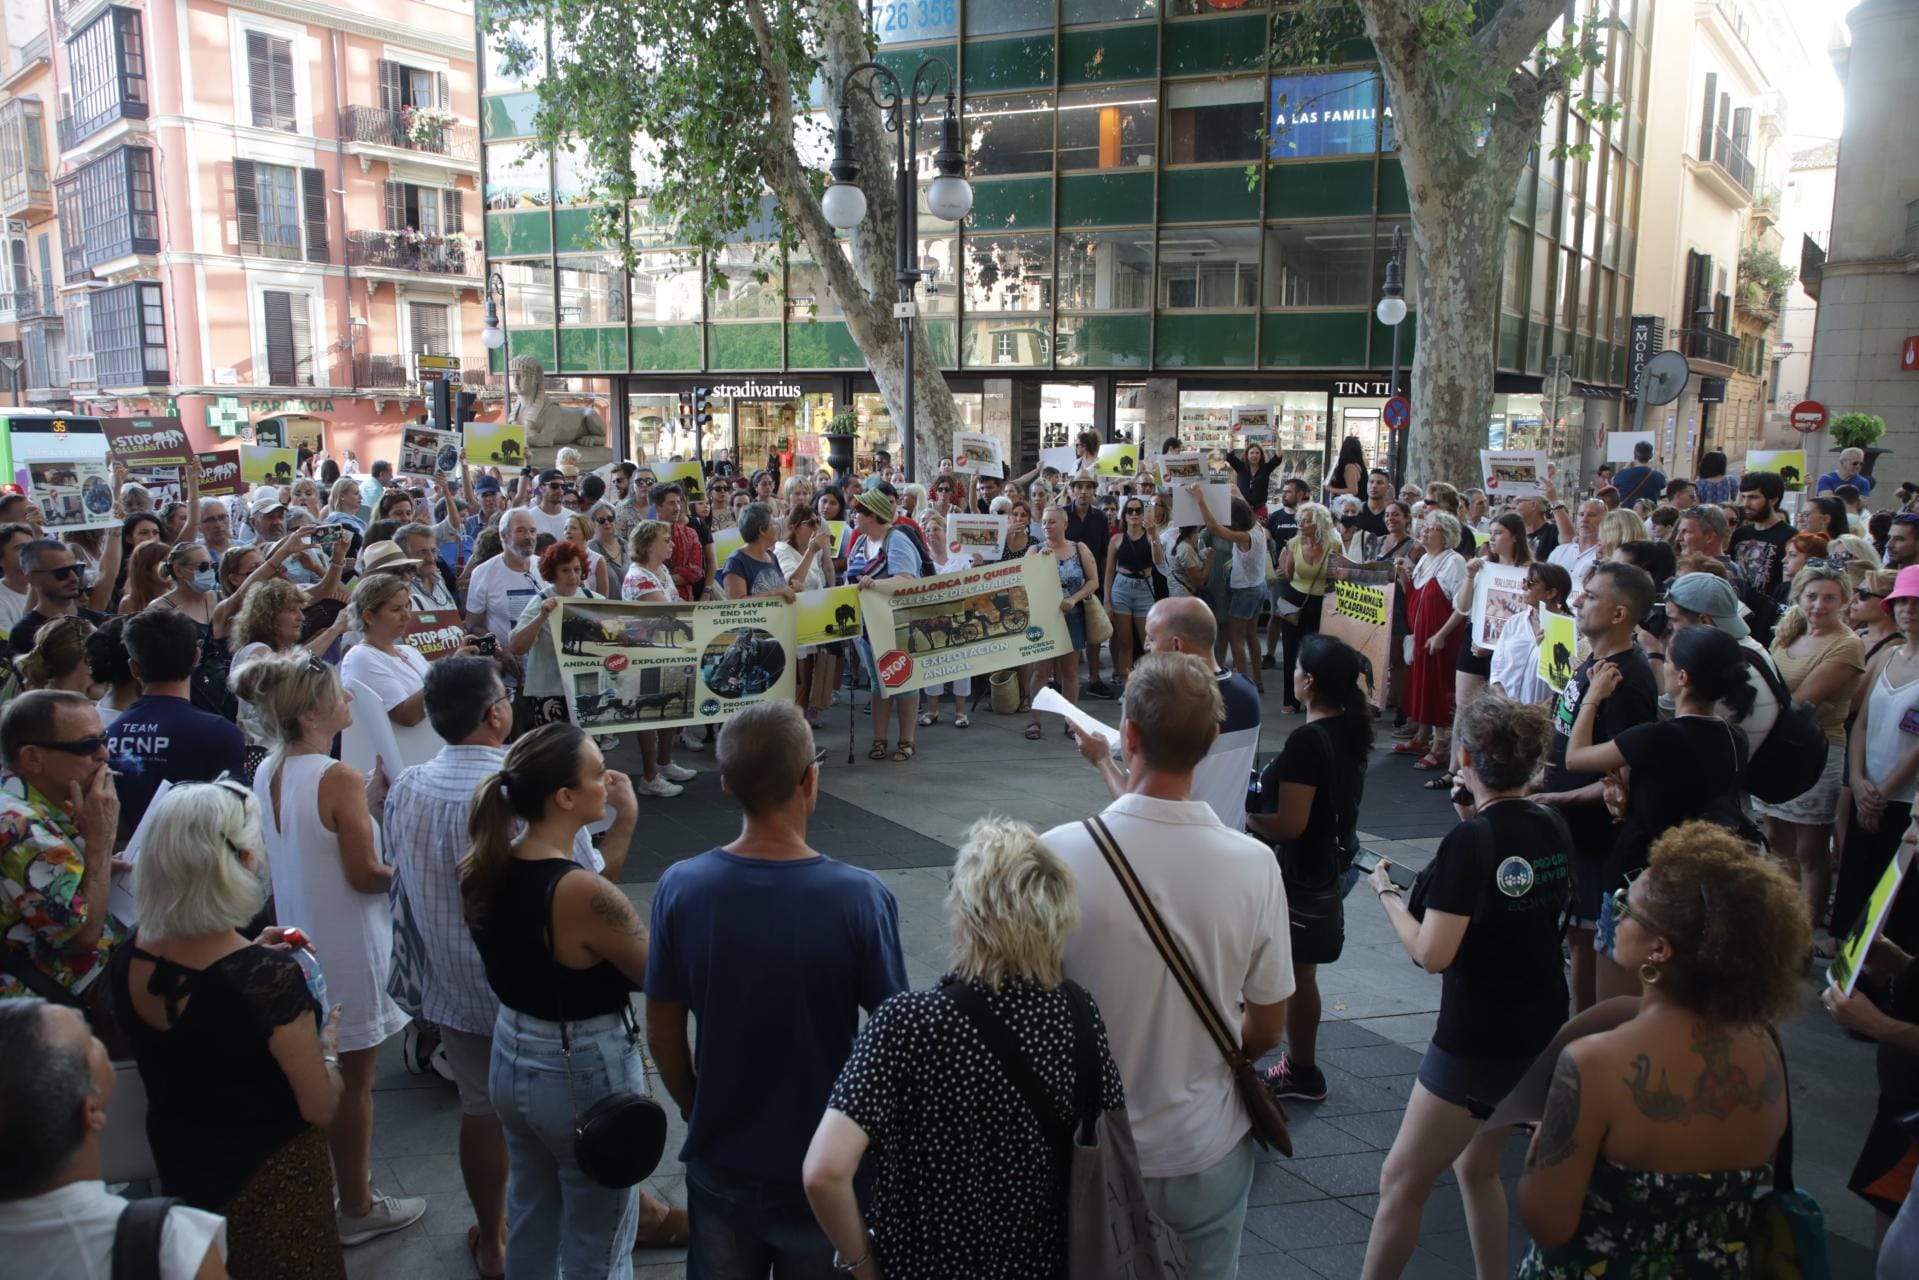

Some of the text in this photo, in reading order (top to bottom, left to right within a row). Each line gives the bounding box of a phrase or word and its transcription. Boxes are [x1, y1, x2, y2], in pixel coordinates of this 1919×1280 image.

[1276, 106, 1393, 125] A LAS FAMILIA
[710, 380, 802, 398] stradivarius
[1334, 382, 1369, 394] TIN
[250, 399, 335, 412] FARMACIA
[52, 420, 66, 432] 35
[894, 564, 1023, 596] MALLORCA NO QUIERE
[949, 586, 966, 598] DE
[966, 574, 1025, 595] CABALLOS
[1335, 586, 1345, 597] NO
[1359, 593, 1383, 608] ANIMALES
[697, 600, 783, 611] TOURIST SAVE ME,
[712, 617, 768, 625] SUFFERING
[418, 642, 444, 654] LERAS
[562, 660, 604, 668] ANIMAL
[608, 657, 626, 668] STOP
[630, 656, 698, 666] EXPLOITATION
[880, 655, 908, 681] STOP
[924, 661, 974, 680] ANIMAL
[723, 699, 765, 708] PROGR
[122, 723, 159, 733] TEAM
[106, 736, 170, 754] RCNP
